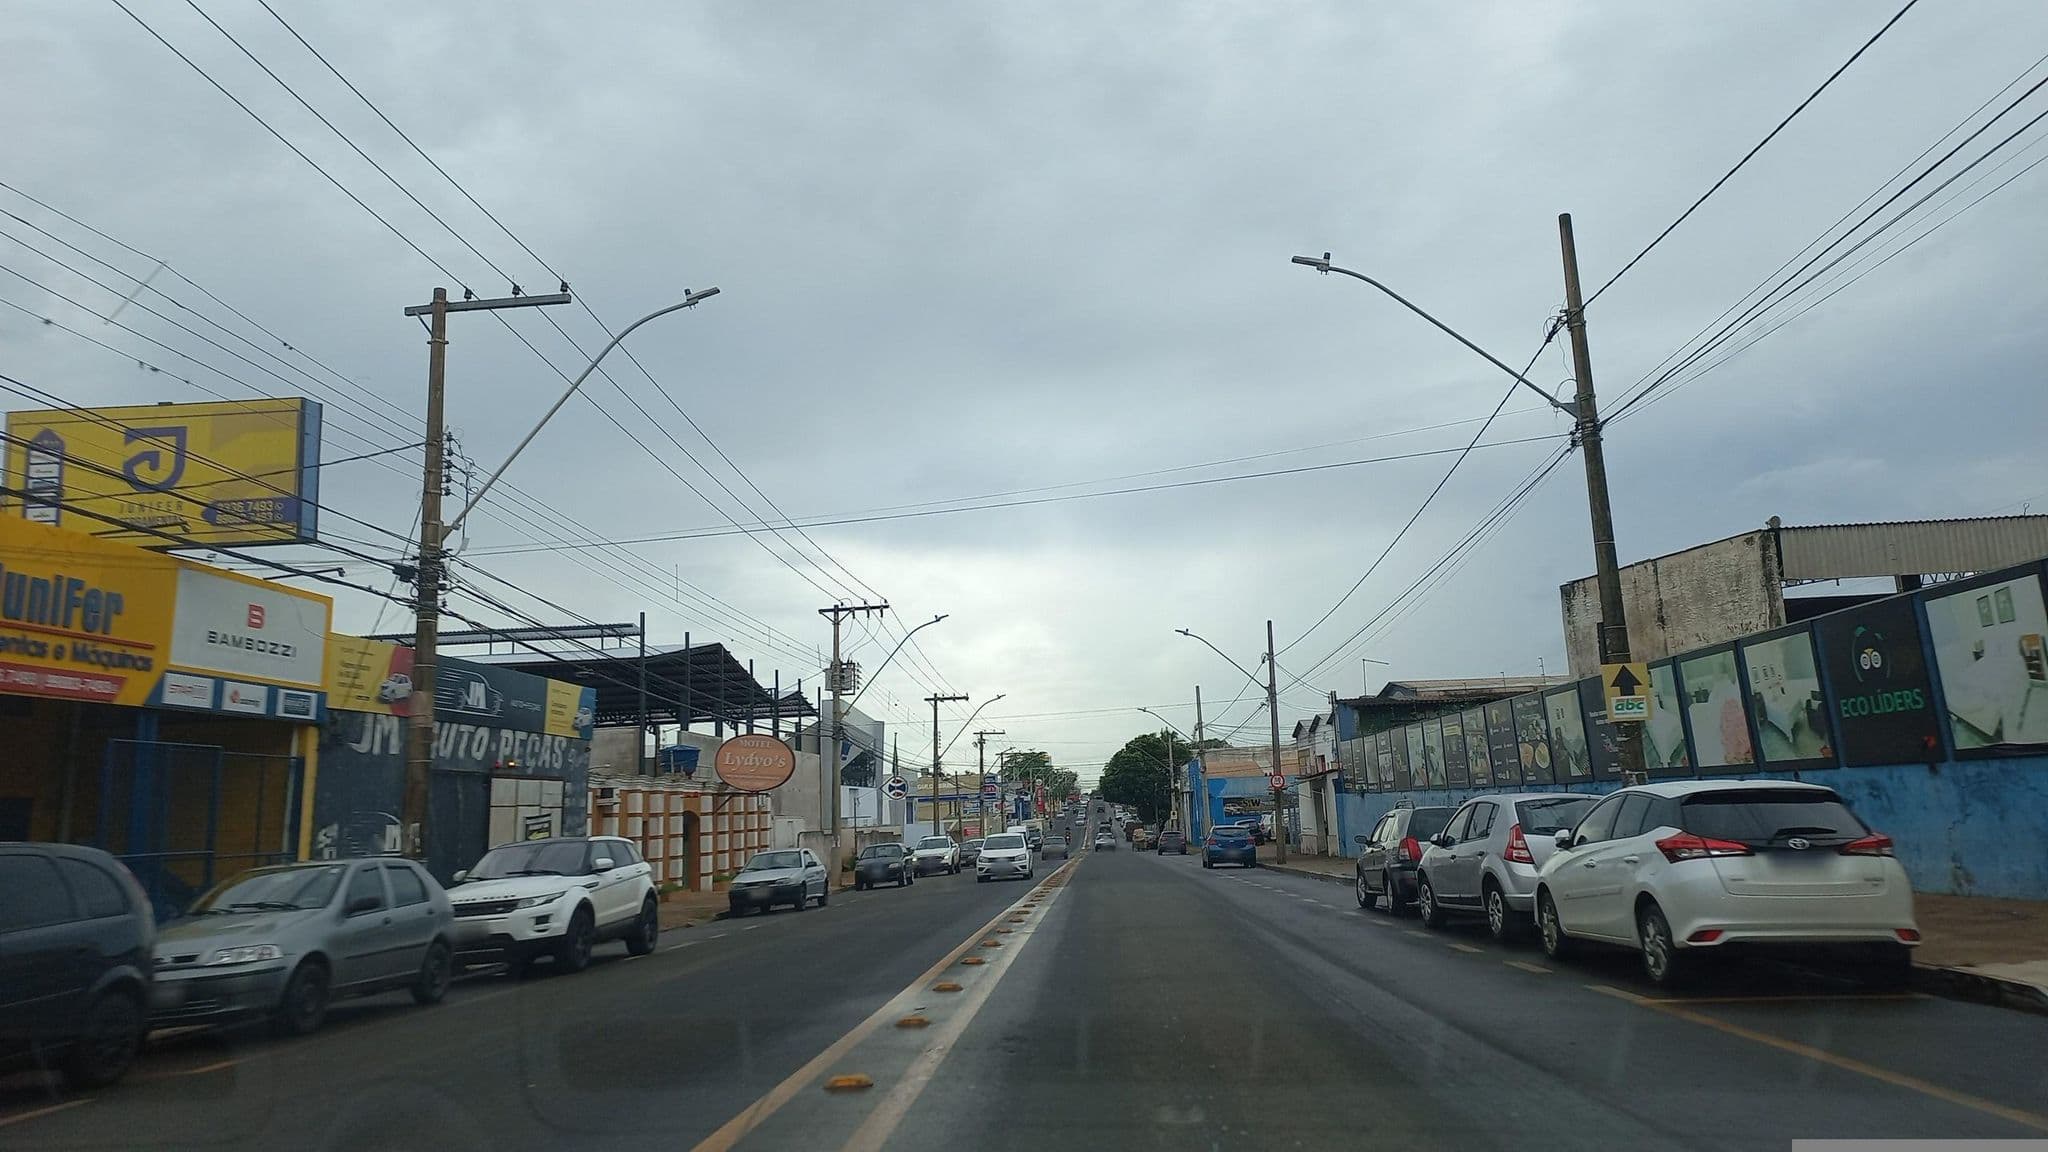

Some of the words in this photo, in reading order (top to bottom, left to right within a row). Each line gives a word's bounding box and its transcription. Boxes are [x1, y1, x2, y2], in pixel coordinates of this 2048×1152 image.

[0, 562, 124, 635] uniFer
[207, 630, 297, 659] BAMBOZZI
[1615, 698, 1645, 711] abc
[1840, 696, 1869, 718] ECO
